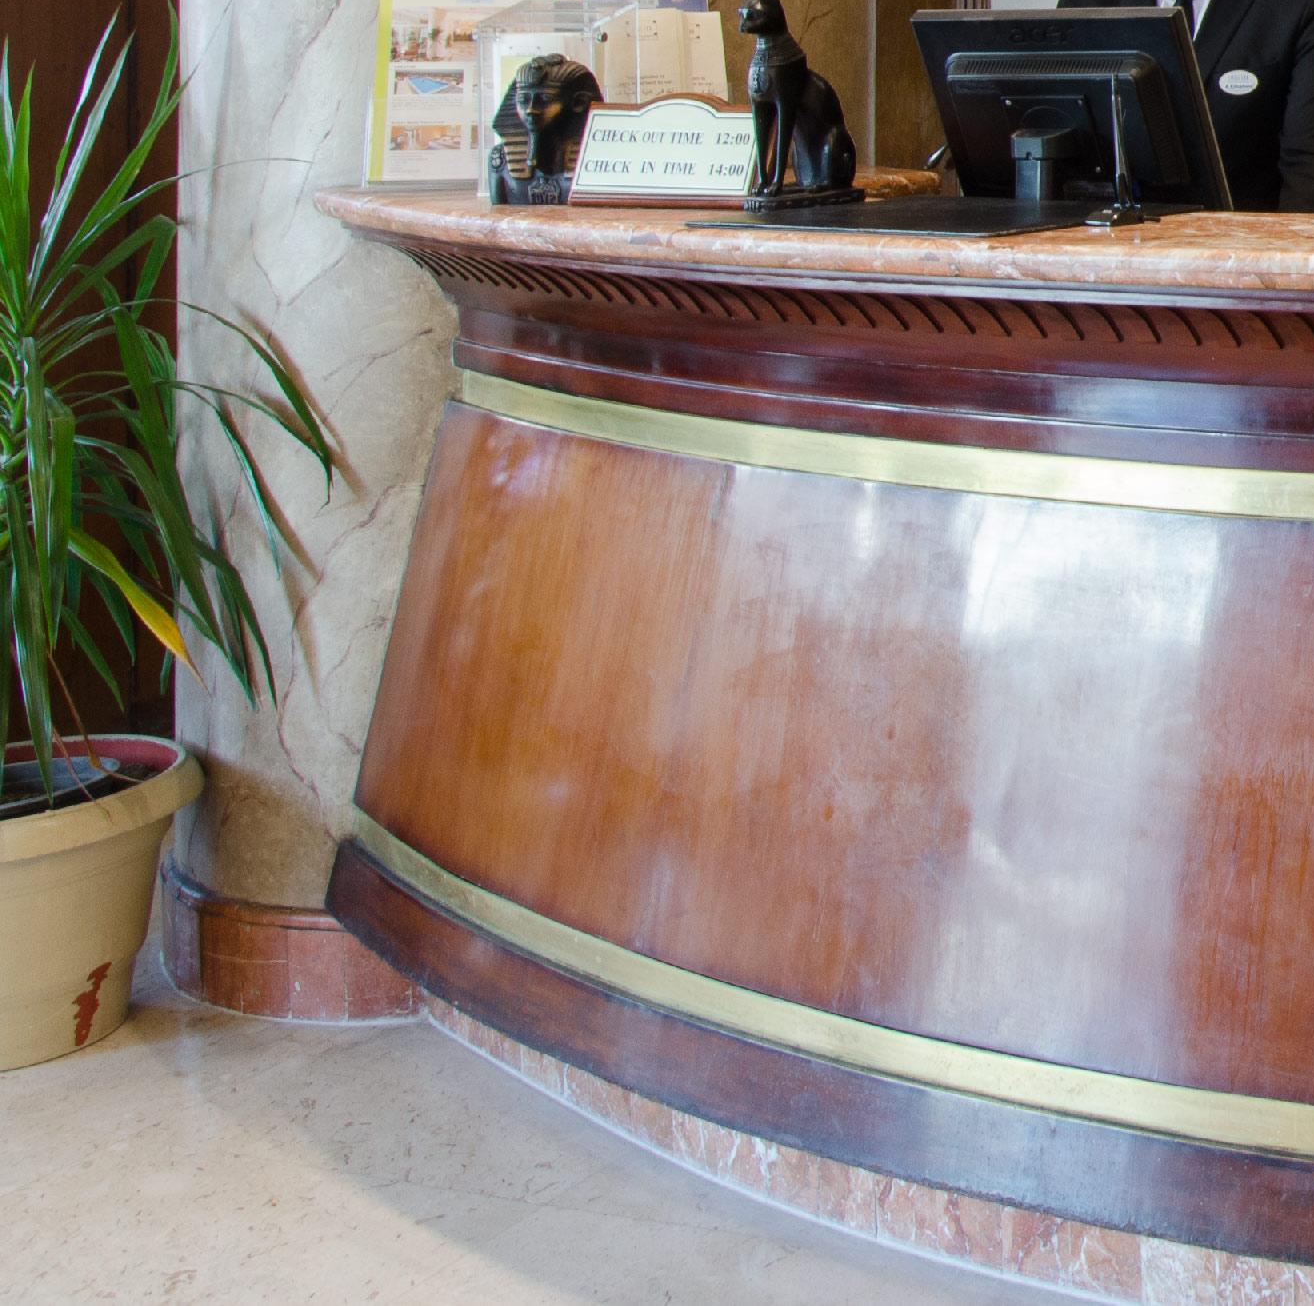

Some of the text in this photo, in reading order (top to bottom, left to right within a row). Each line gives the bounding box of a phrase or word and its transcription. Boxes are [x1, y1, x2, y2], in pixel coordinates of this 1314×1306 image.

[592, 128, 750, 145] CHECK OUT TIME 12:00
[584, 159, 745, 176] CHECK IN TIME 14:00
